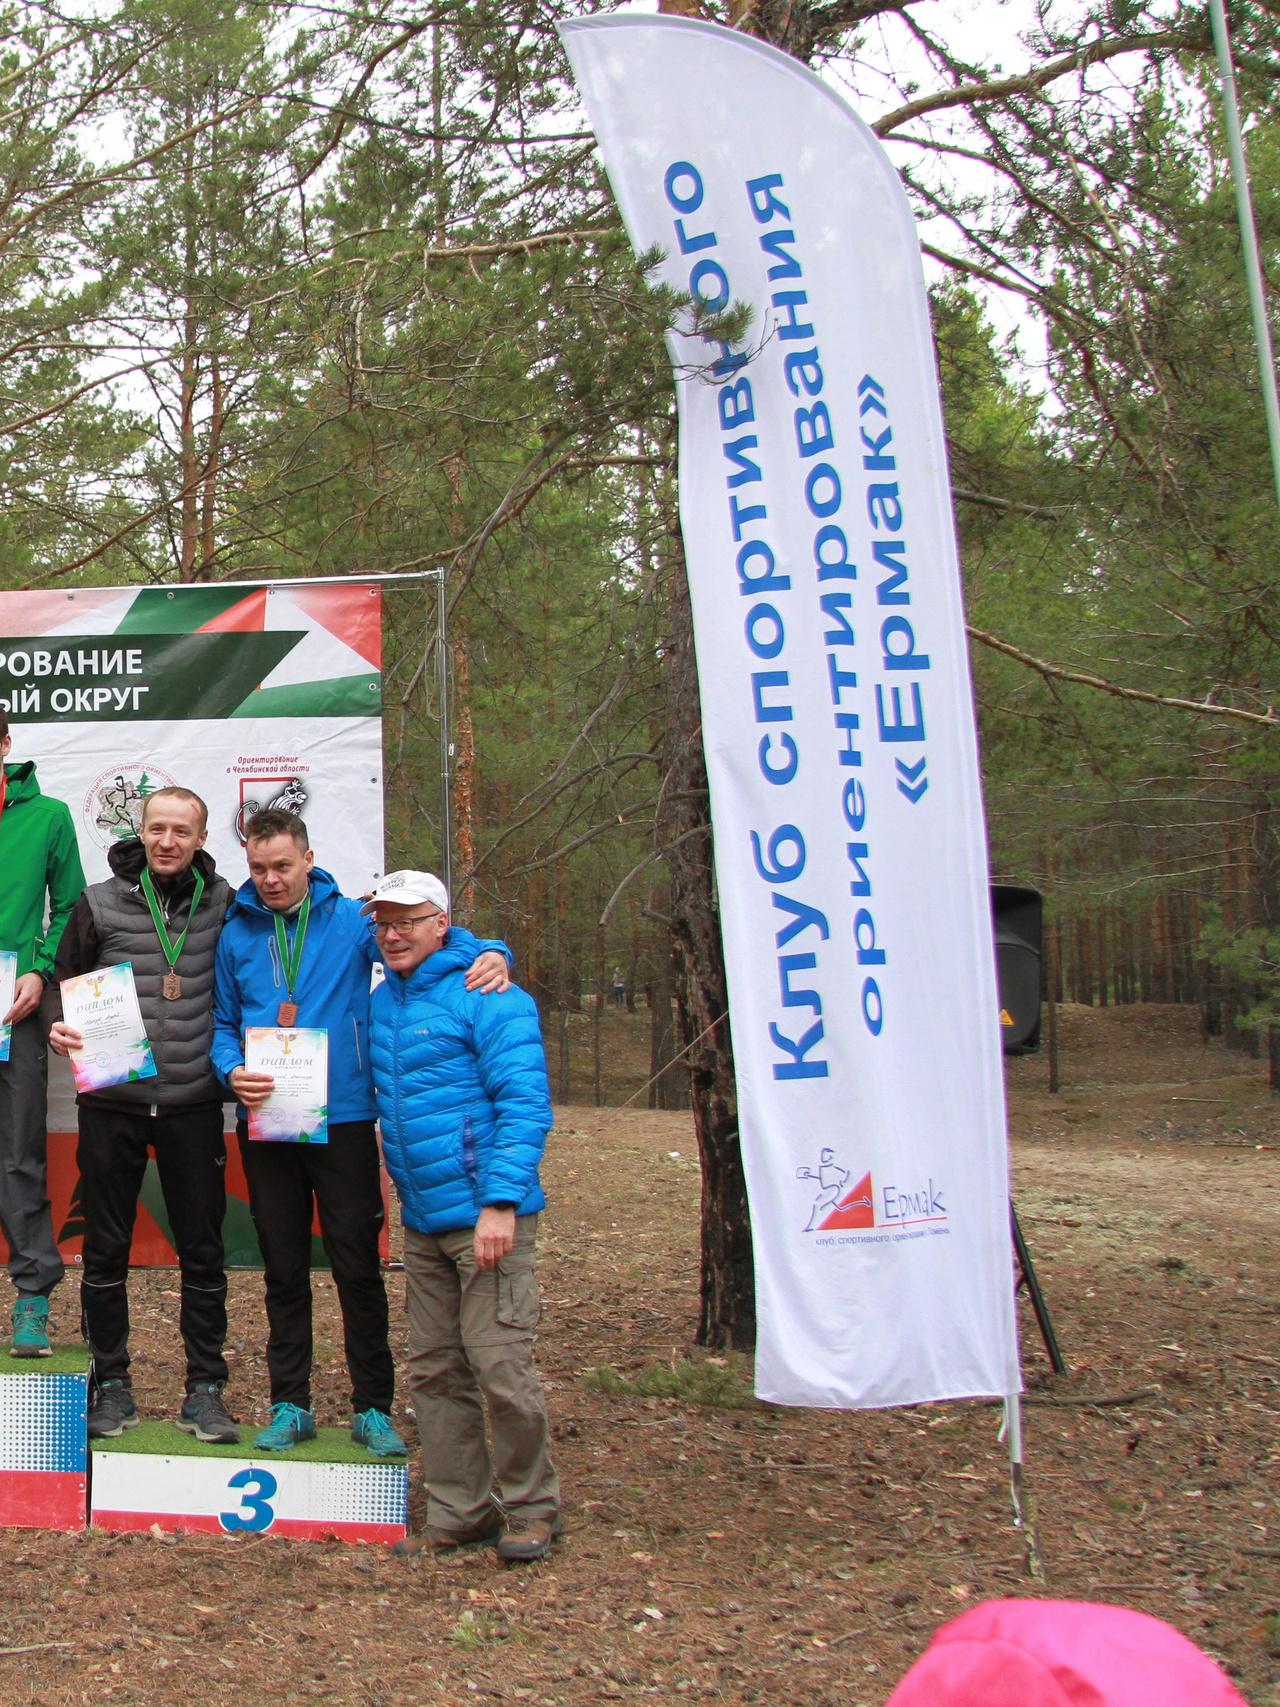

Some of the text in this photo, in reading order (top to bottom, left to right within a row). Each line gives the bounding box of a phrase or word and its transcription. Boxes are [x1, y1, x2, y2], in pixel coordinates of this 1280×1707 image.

[746, 173, 886, 1036] ориентирования
[857, 373, 930, 805] «Ермак»
[50, 686, 150, 714] ОКРУГ
[232, 764, 278, 774] Челябинской
[280, 764, 310, 772] области
[237, 755, 299, 765] Ориентирование
[84, 779, 104, 813] ФЕДЕРАЦИЯ
[102, 764, 145, 781] СПОРТИВНОГО
[749, 823, 830, 1082] Клуб
[75, 995, 124, 1014] ДИПЛОМ
[259, 1057, 314, 1066] ДИПЛОМ
[882, 1178, 946, 1229] Ермак
[815, 1235, 835, 1247] клуб
[838, 1235, 889, 1245] спортивного
[220, 1467, 278, 1532] 3
